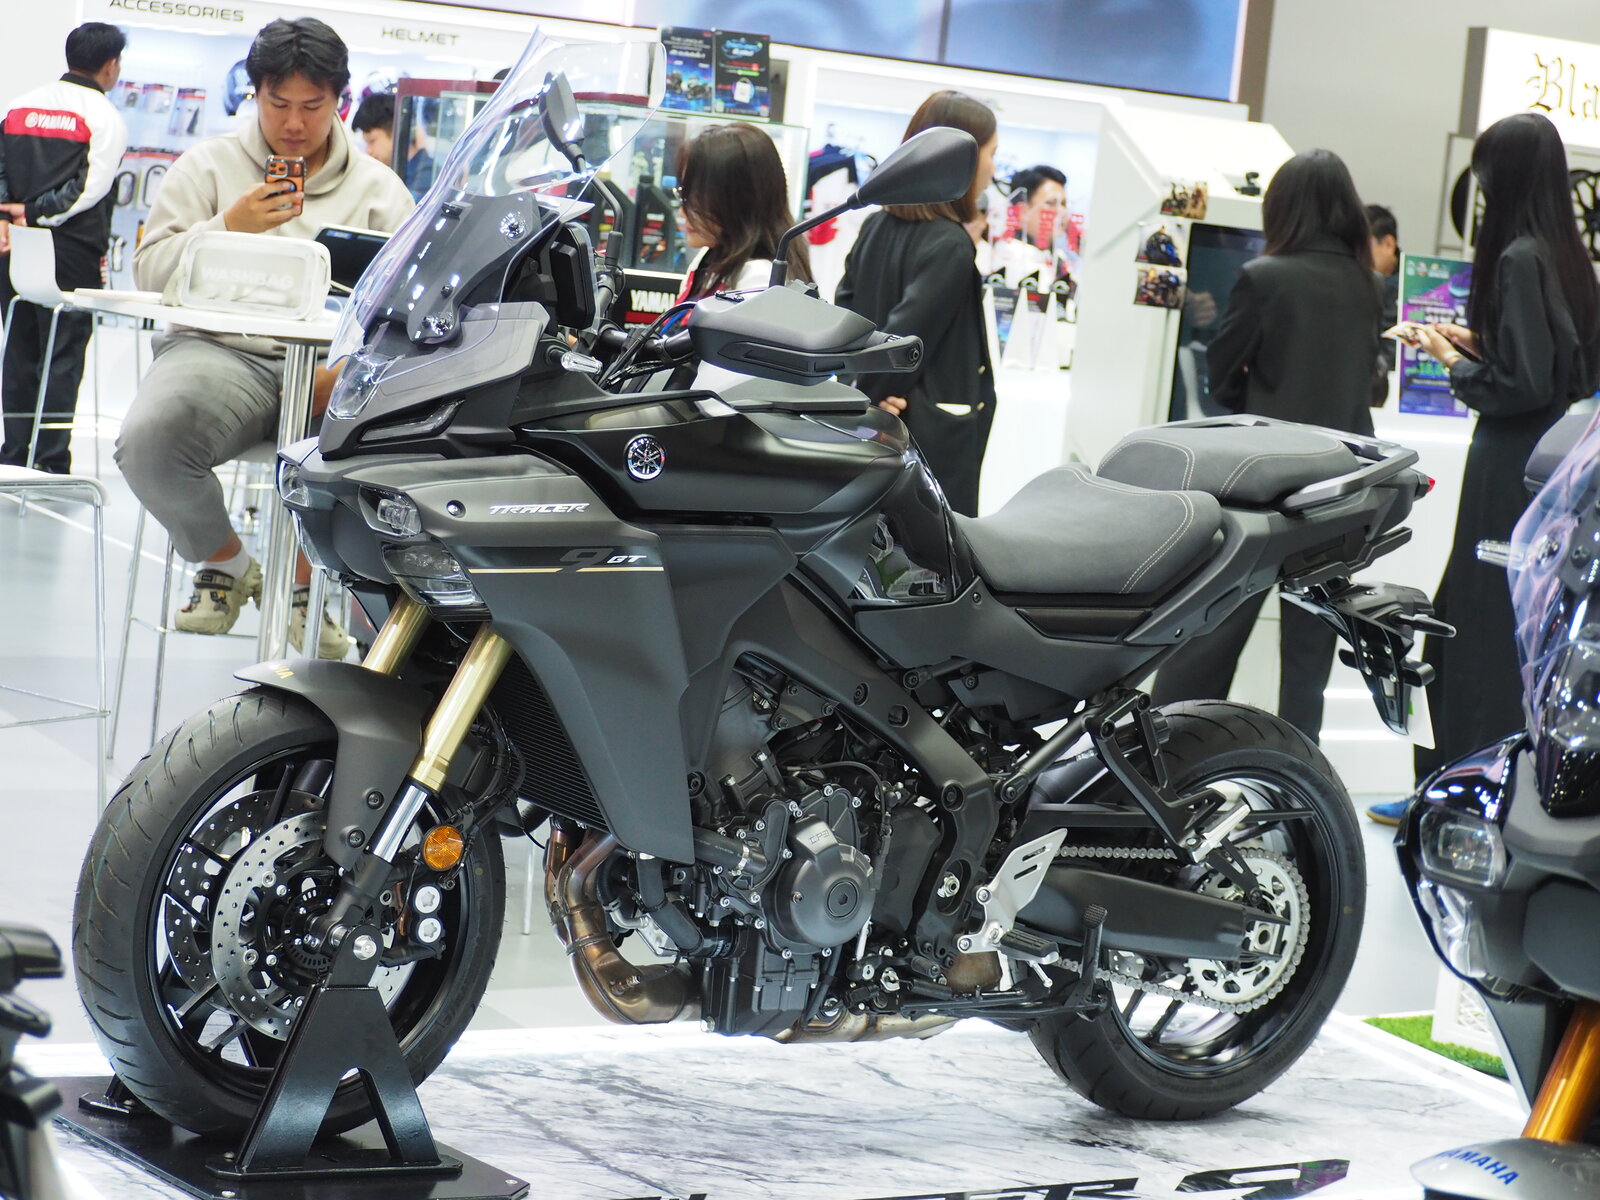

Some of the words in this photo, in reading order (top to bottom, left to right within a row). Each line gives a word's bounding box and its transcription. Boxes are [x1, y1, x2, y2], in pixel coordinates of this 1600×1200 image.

[109, 0, 245, 21] ACCESSORIES
[381, 26, 464, 46] HELMET
[38, 112, 77, 131] YAMAHA
[489, 503, 590, 515] TRACER
[558, 548, 614, 575] 9
[607, 555, 647, 564] GT
